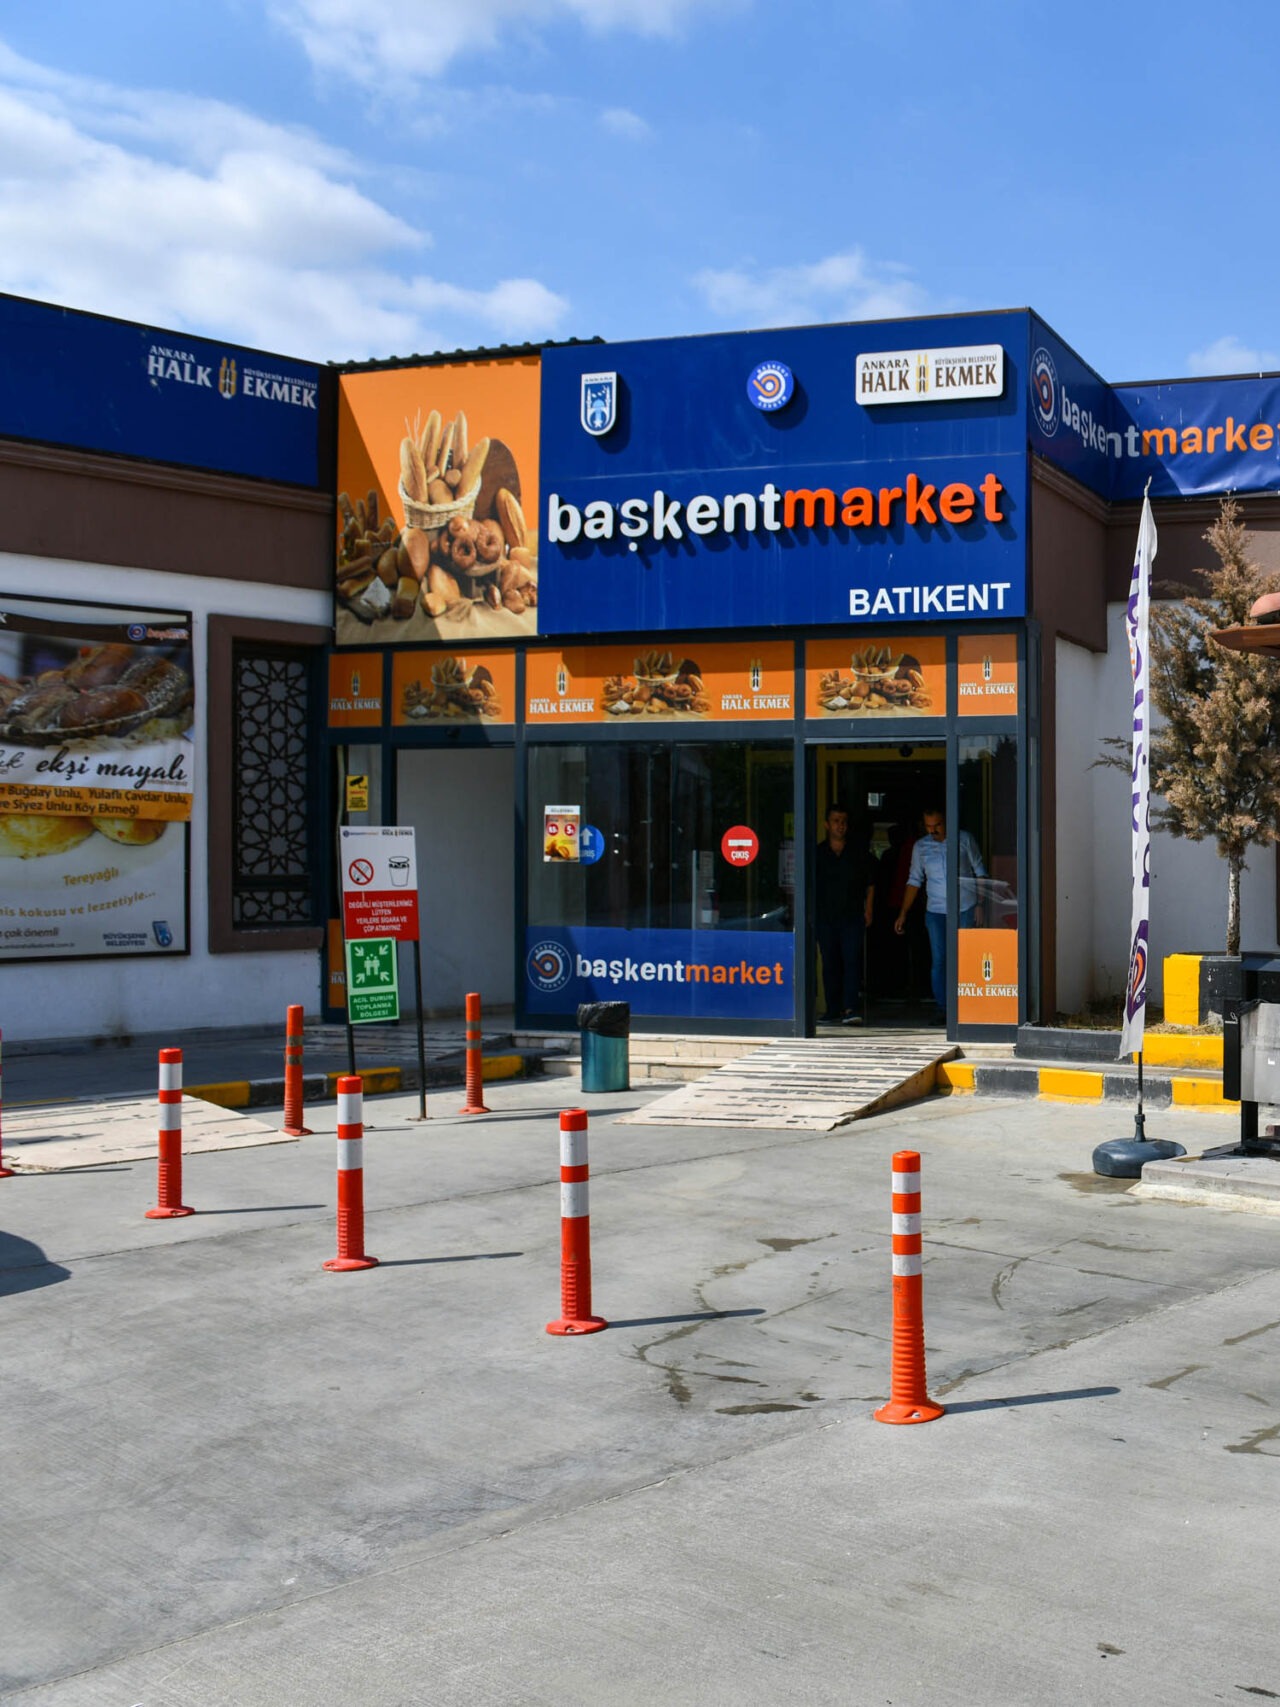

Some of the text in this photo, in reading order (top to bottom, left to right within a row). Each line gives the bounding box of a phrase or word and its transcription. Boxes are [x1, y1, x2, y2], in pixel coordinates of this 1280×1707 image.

[150, 345, 196, 363] ANKARA
[862, 358, 910, 371] ANKARA
[147, 355, 317, 410] HALK EKMEK
[862, 363, 997, 393] HALK EKMEK
[548, 472, 1003, 552] başkentmarket
[849, 582, 1011, 616] BATIKENT
[960, 686, 983, 695] HALK
[986, 685, 1015, 694] EKMEK
[530, 702, 594, 713] HALK EKMEK
[722, 698, 790, 710] HALK EKMEK
[36, 747, 90, 780] ekşi
[96, 754, 187, 789] mayalı
[8, 786, 51, 799] Buğday
[125, 791, 161, 804] Çavdar
[13, 800, 43, 812] Siyez
[75, 803, 96, 815] Köy
[99, 803, 140, 817] Ekmeği
[63, 867, 120, 887] Tereyağlı
[19, 907, 66, 917] kokusu
[70, 906, 84, 915] ve
[575, 953, 784, 985] başkentmarket
[958, 987, 1018, 997] HALK EKMEK
